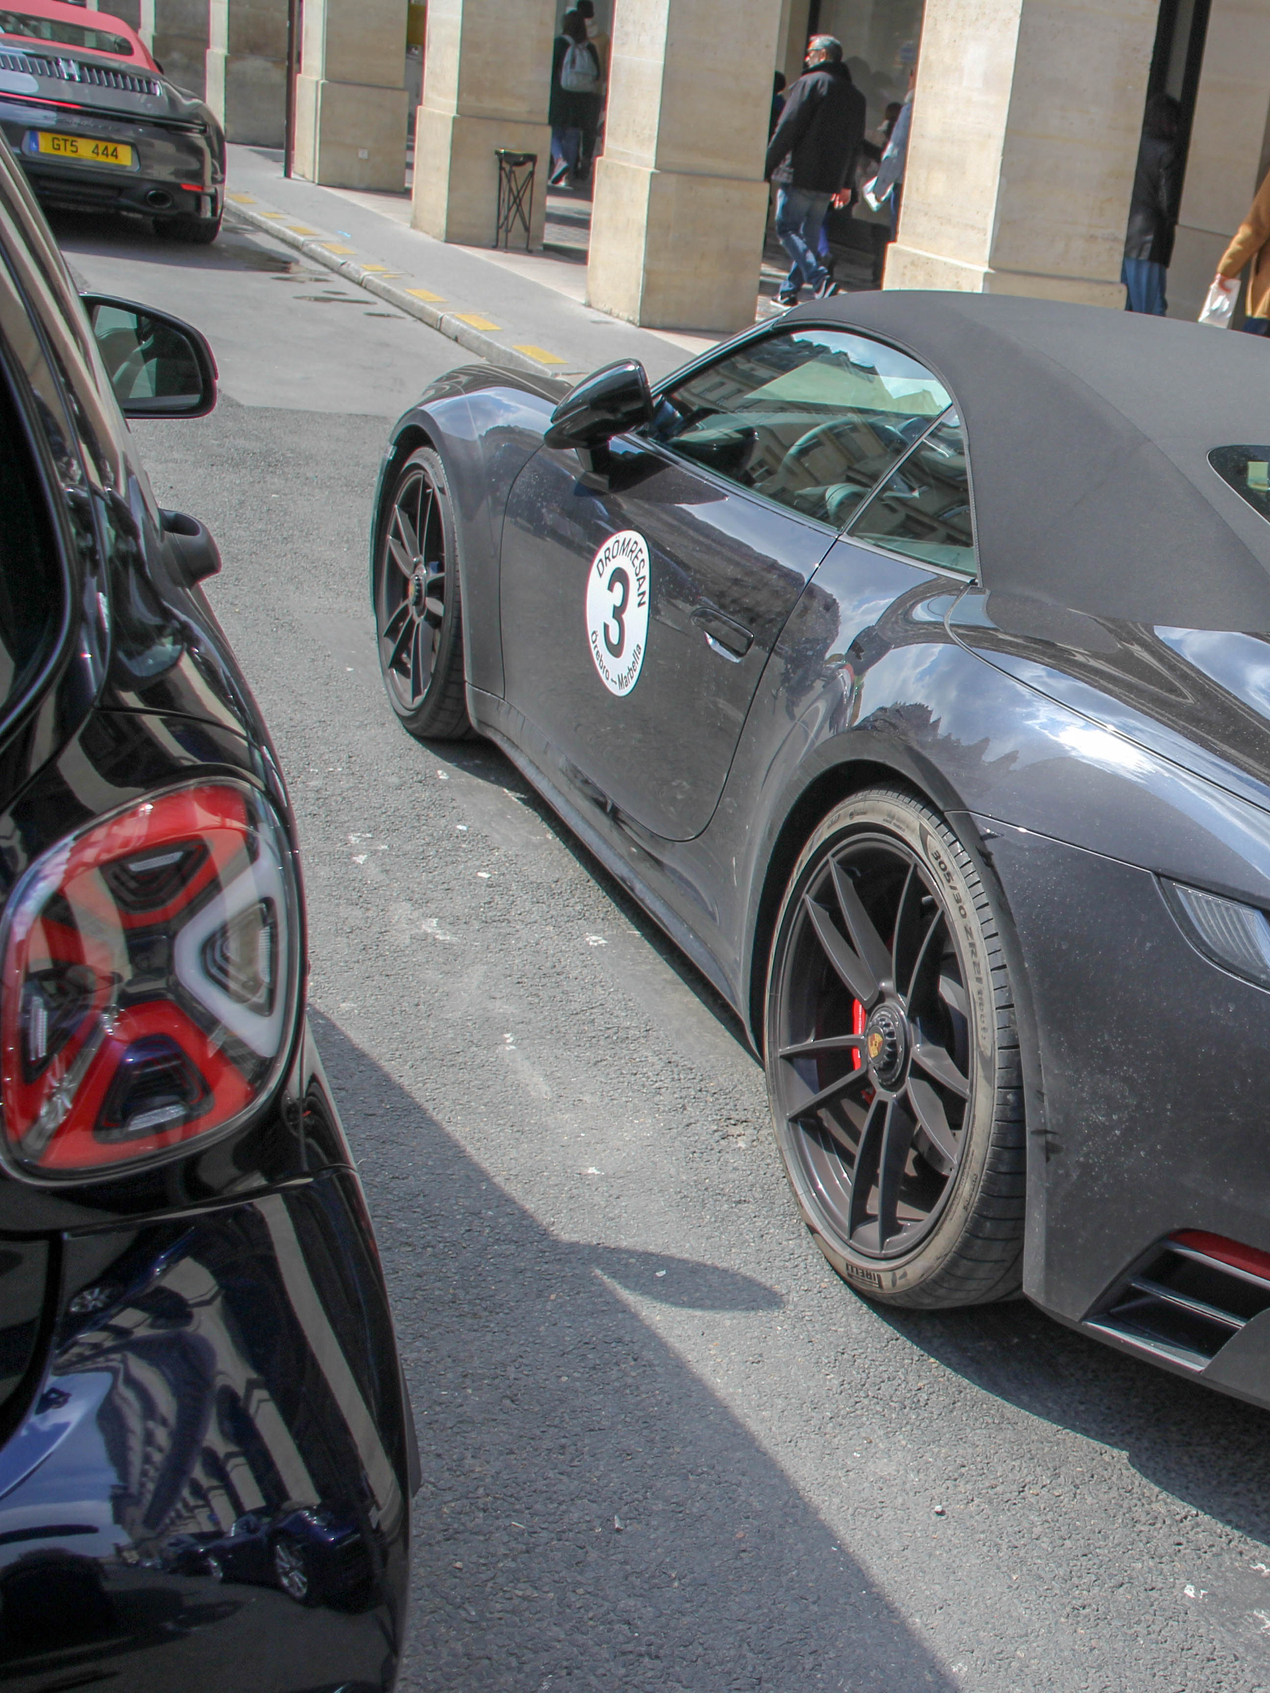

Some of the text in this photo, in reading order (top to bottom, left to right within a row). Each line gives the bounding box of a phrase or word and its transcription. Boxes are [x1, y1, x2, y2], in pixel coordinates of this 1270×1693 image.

[92, 144, 118, 159] 444
[596, 535, 647, 608] DRÖMRESAN
[603, 567, 631, 659] 3
[617, 643, 642, 691] Marbella
[931, 850, 967, 919] 305/30
[846, 1262, 884, 1289] PIRELLI
